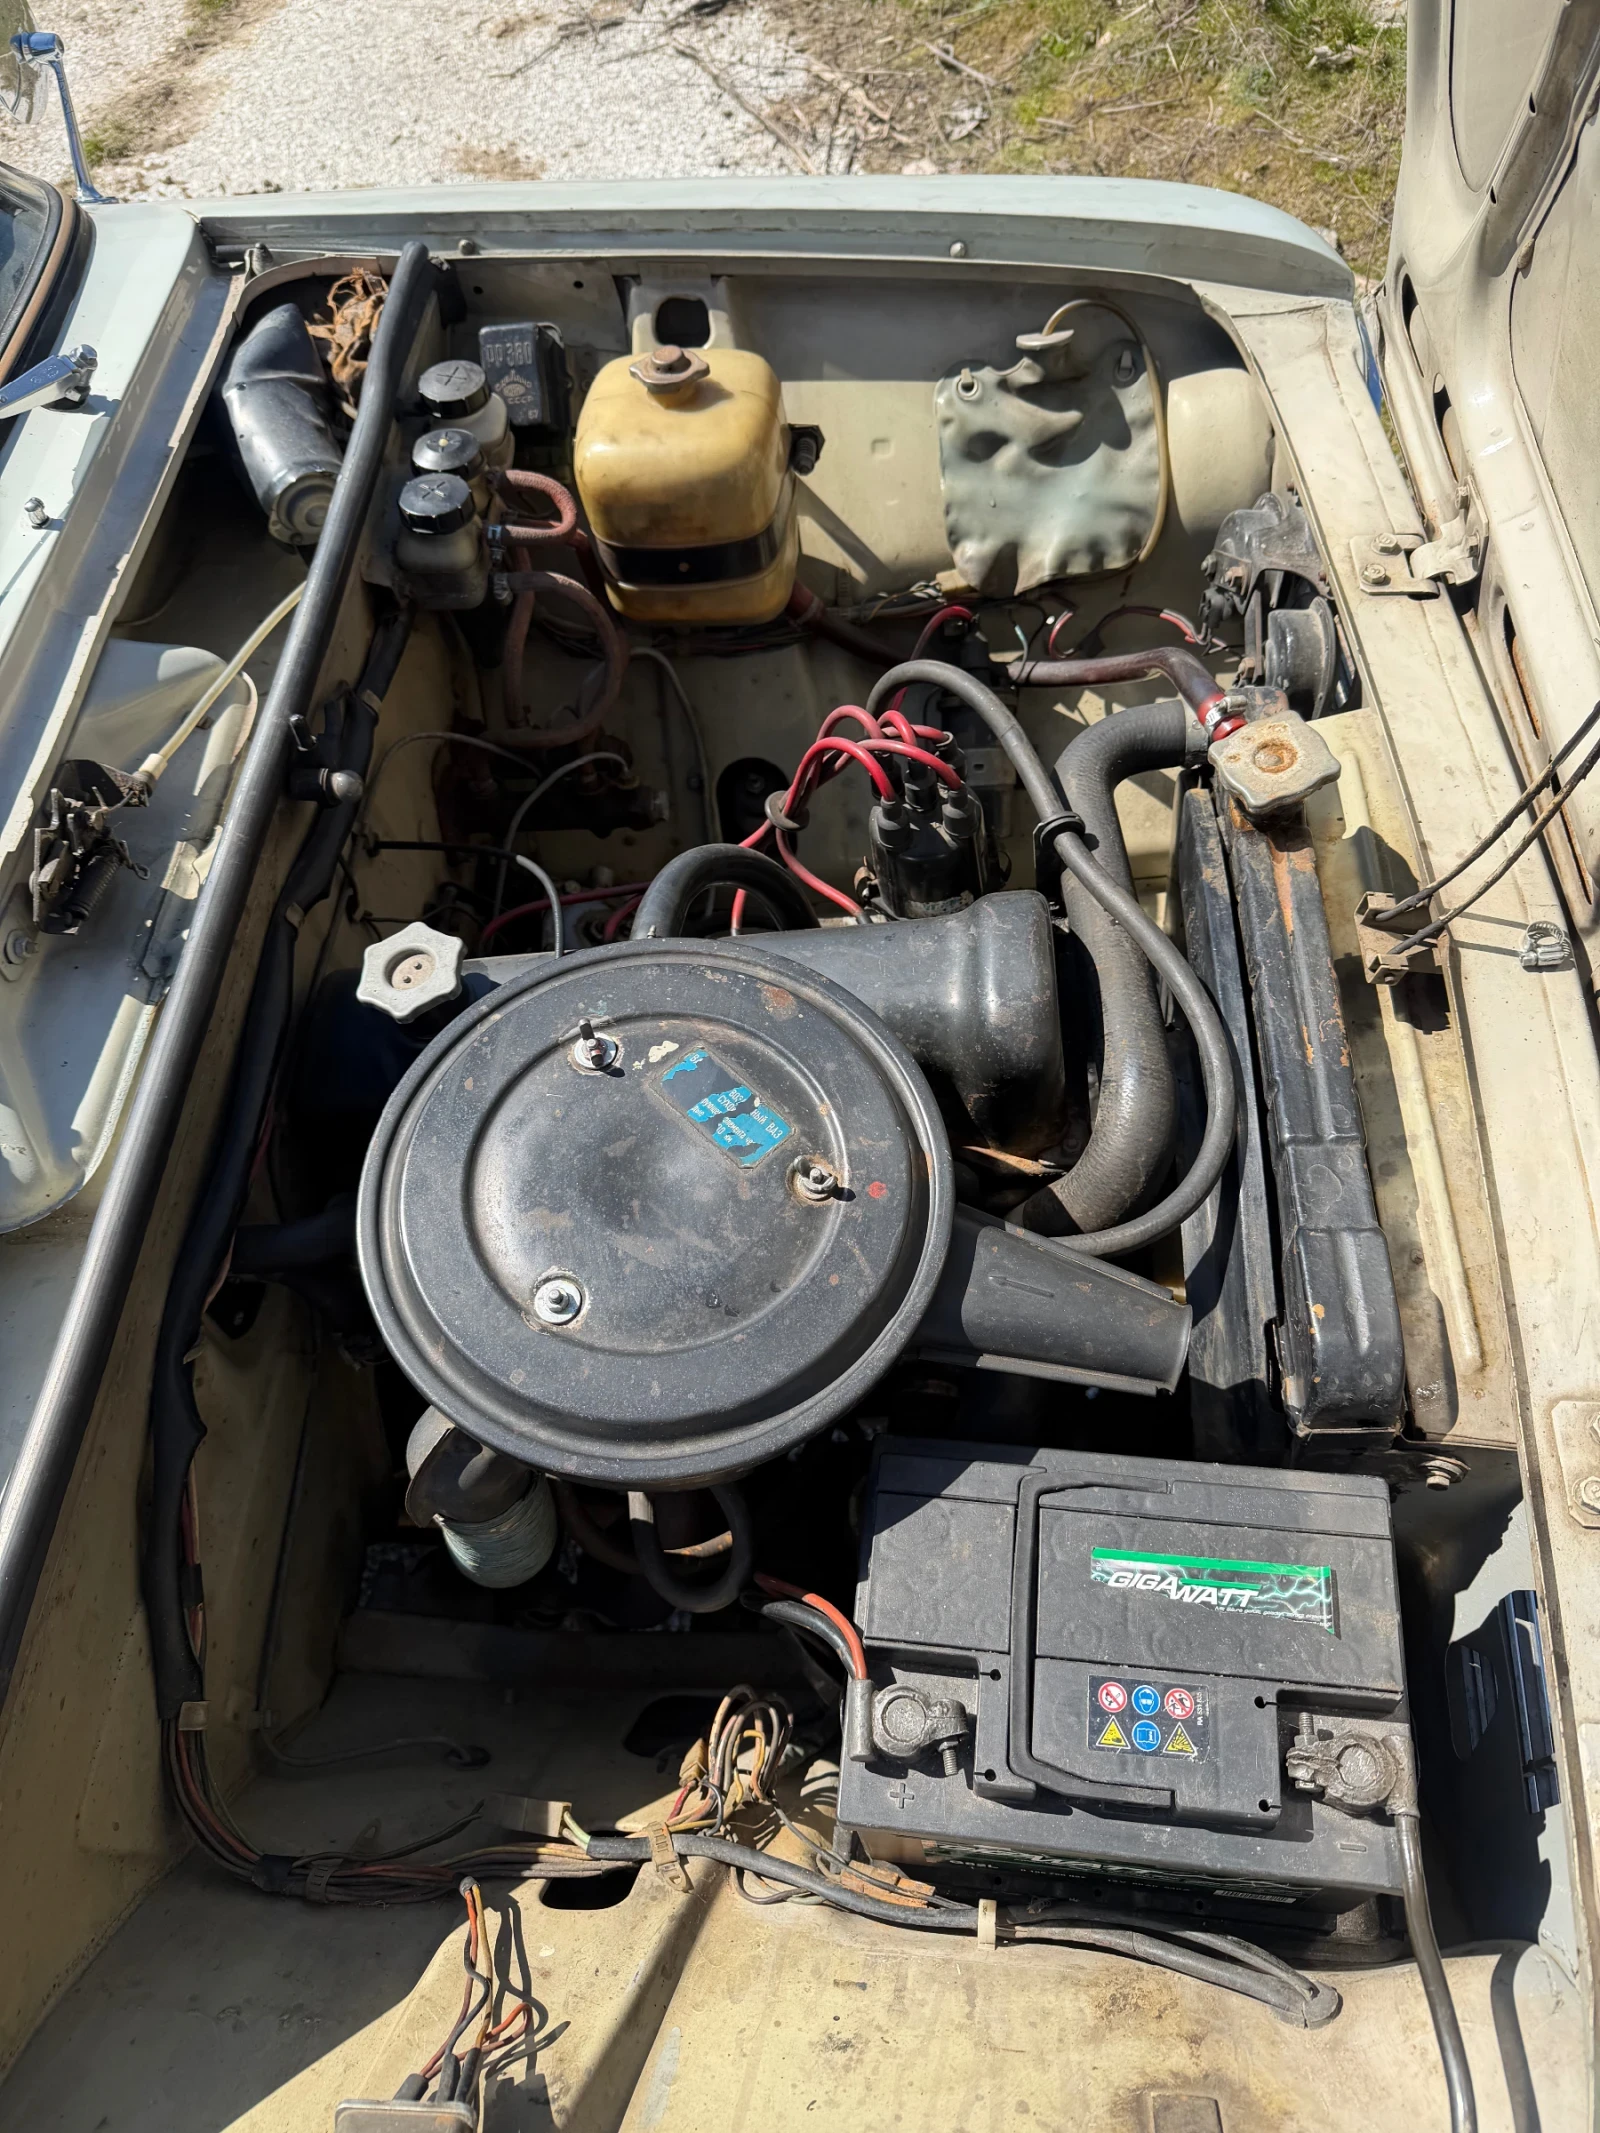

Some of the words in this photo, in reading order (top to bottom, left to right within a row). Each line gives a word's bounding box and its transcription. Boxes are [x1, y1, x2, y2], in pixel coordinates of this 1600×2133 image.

[508, 395, 534, 405] СССР
[765, 1122, 783, 1139] ВАЗ
[1108, 1571, 1260, 1608] GIGAWATT
